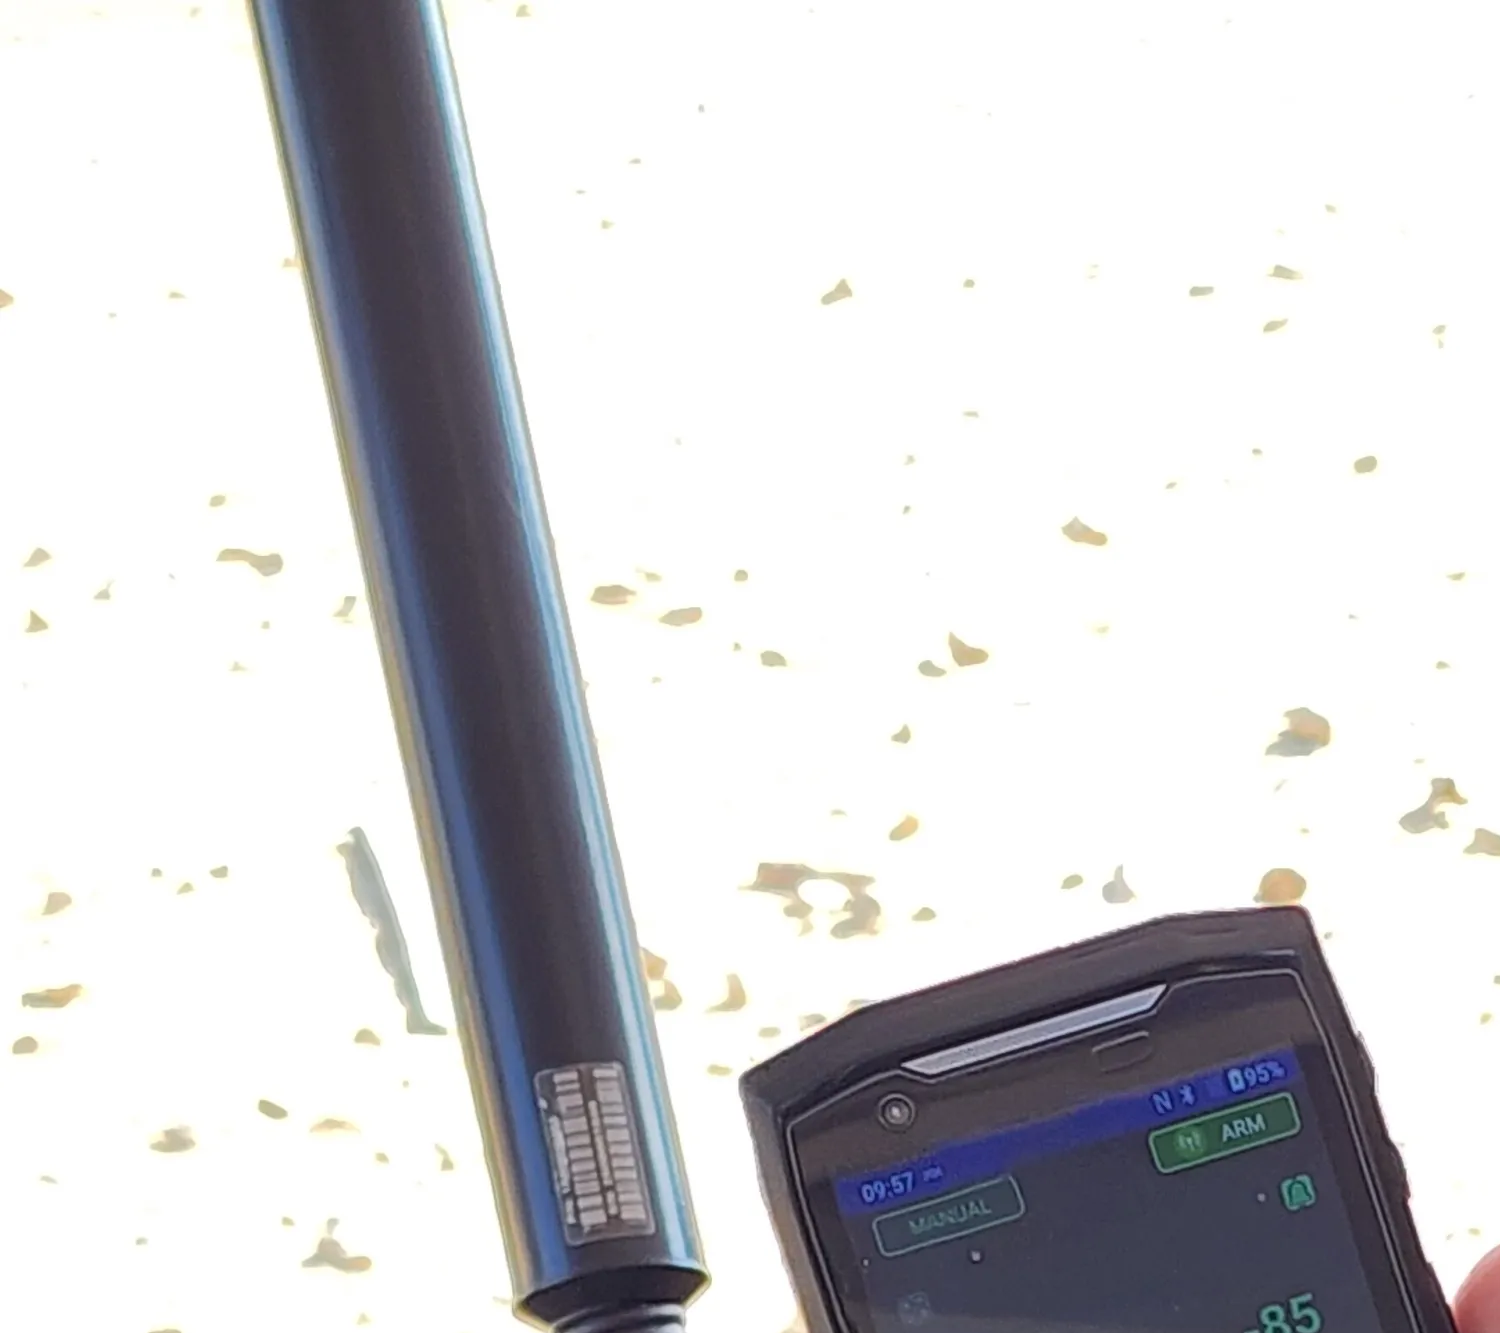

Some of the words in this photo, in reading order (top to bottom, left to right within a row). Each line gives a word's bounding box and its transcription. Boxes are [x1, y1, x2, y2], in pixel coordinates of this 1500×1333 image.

[1222, 1113, 1267, 1142] ARM
[861, 1171, 914, 1204] 09:57
[908, 1199, 993, 1236] MANUAL
